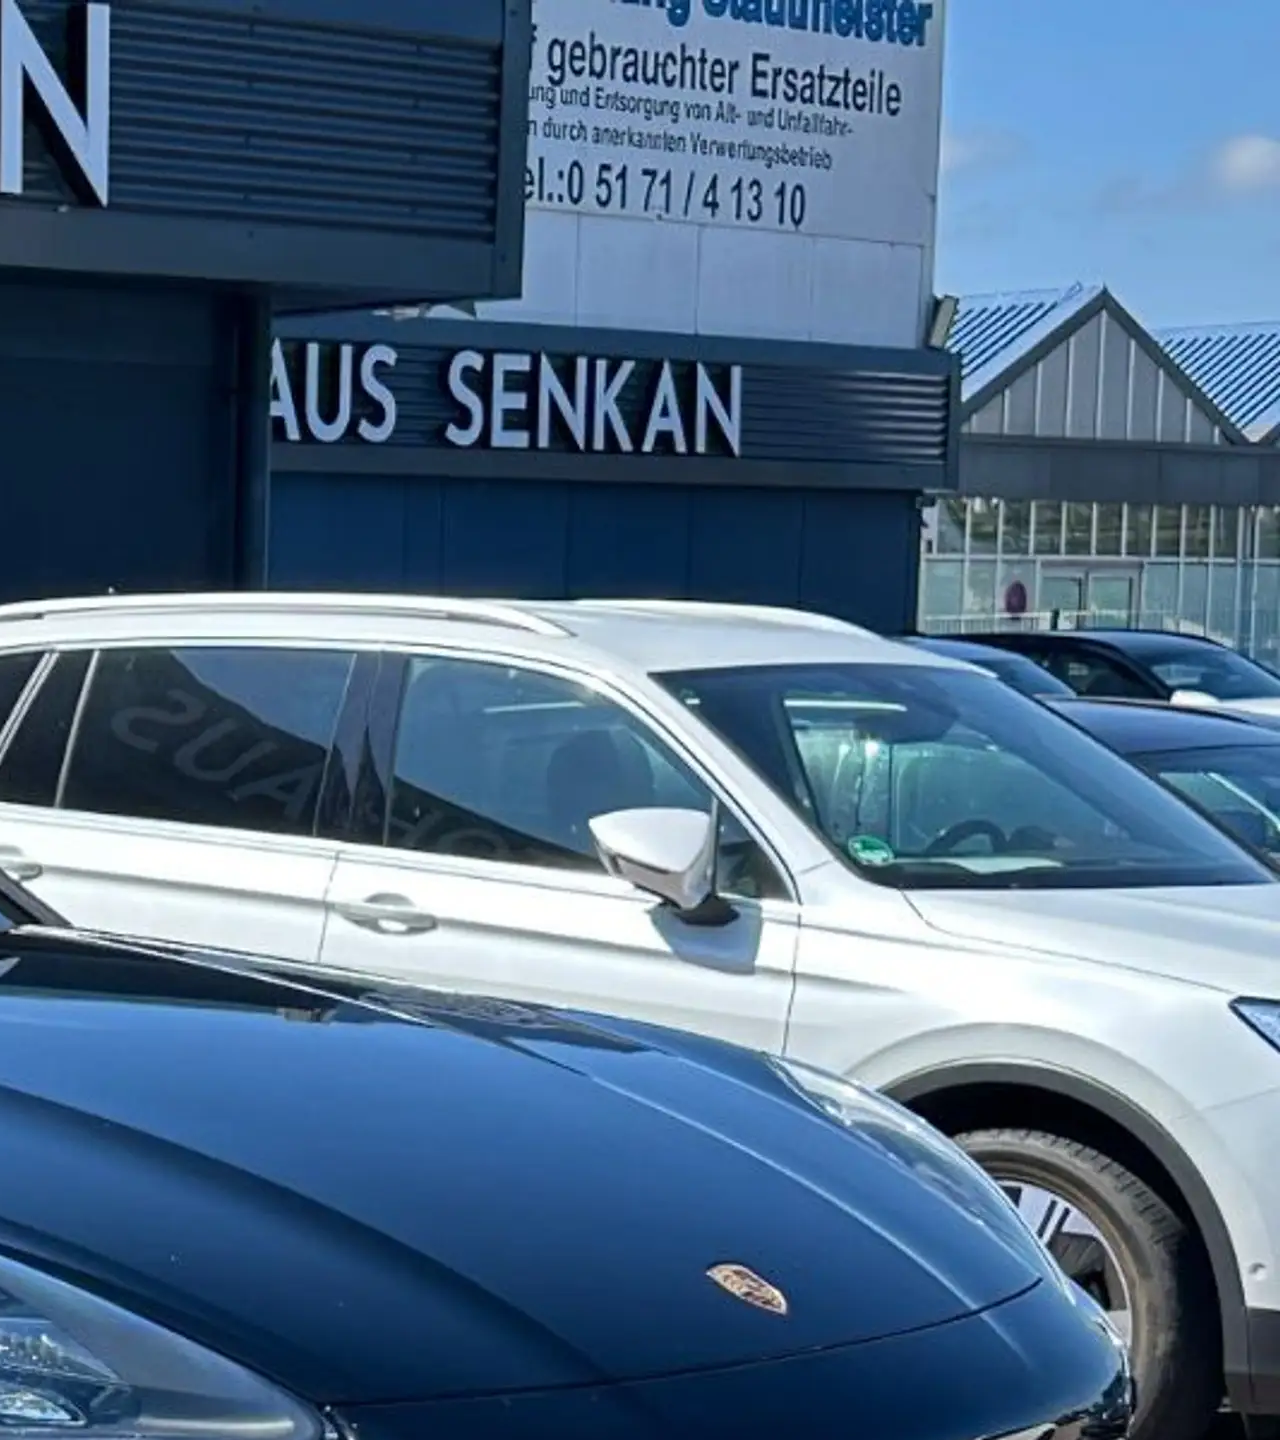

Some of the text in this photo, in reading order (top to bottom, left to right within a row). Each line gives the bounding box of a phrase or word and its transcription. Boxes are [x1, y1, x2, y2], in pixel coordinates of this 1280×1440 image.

[546, 31, 740, 95] gebrauchter
[751, 52, 902, 116] Ersatzteile
[560, 86, 590, 107] und
[595, 86, 680, 124] Entsorgung
[683, 102, 712, 121] von
[747, 107, 775, 128] und
[543, 115, 588, 142] durch
[591, 125, 687, 153] anerkannten
[689, 131, 833, 170] Verwertungsbetrieb
[595, 162, 629, 210] 51
[641, 167, 672, 215] 71
[701, 173, 721, 219] 4
[730, 176, 763, 222] 13
[773, 181, 807, 227] 10
[445, 349, 742, 458] SENKAN
